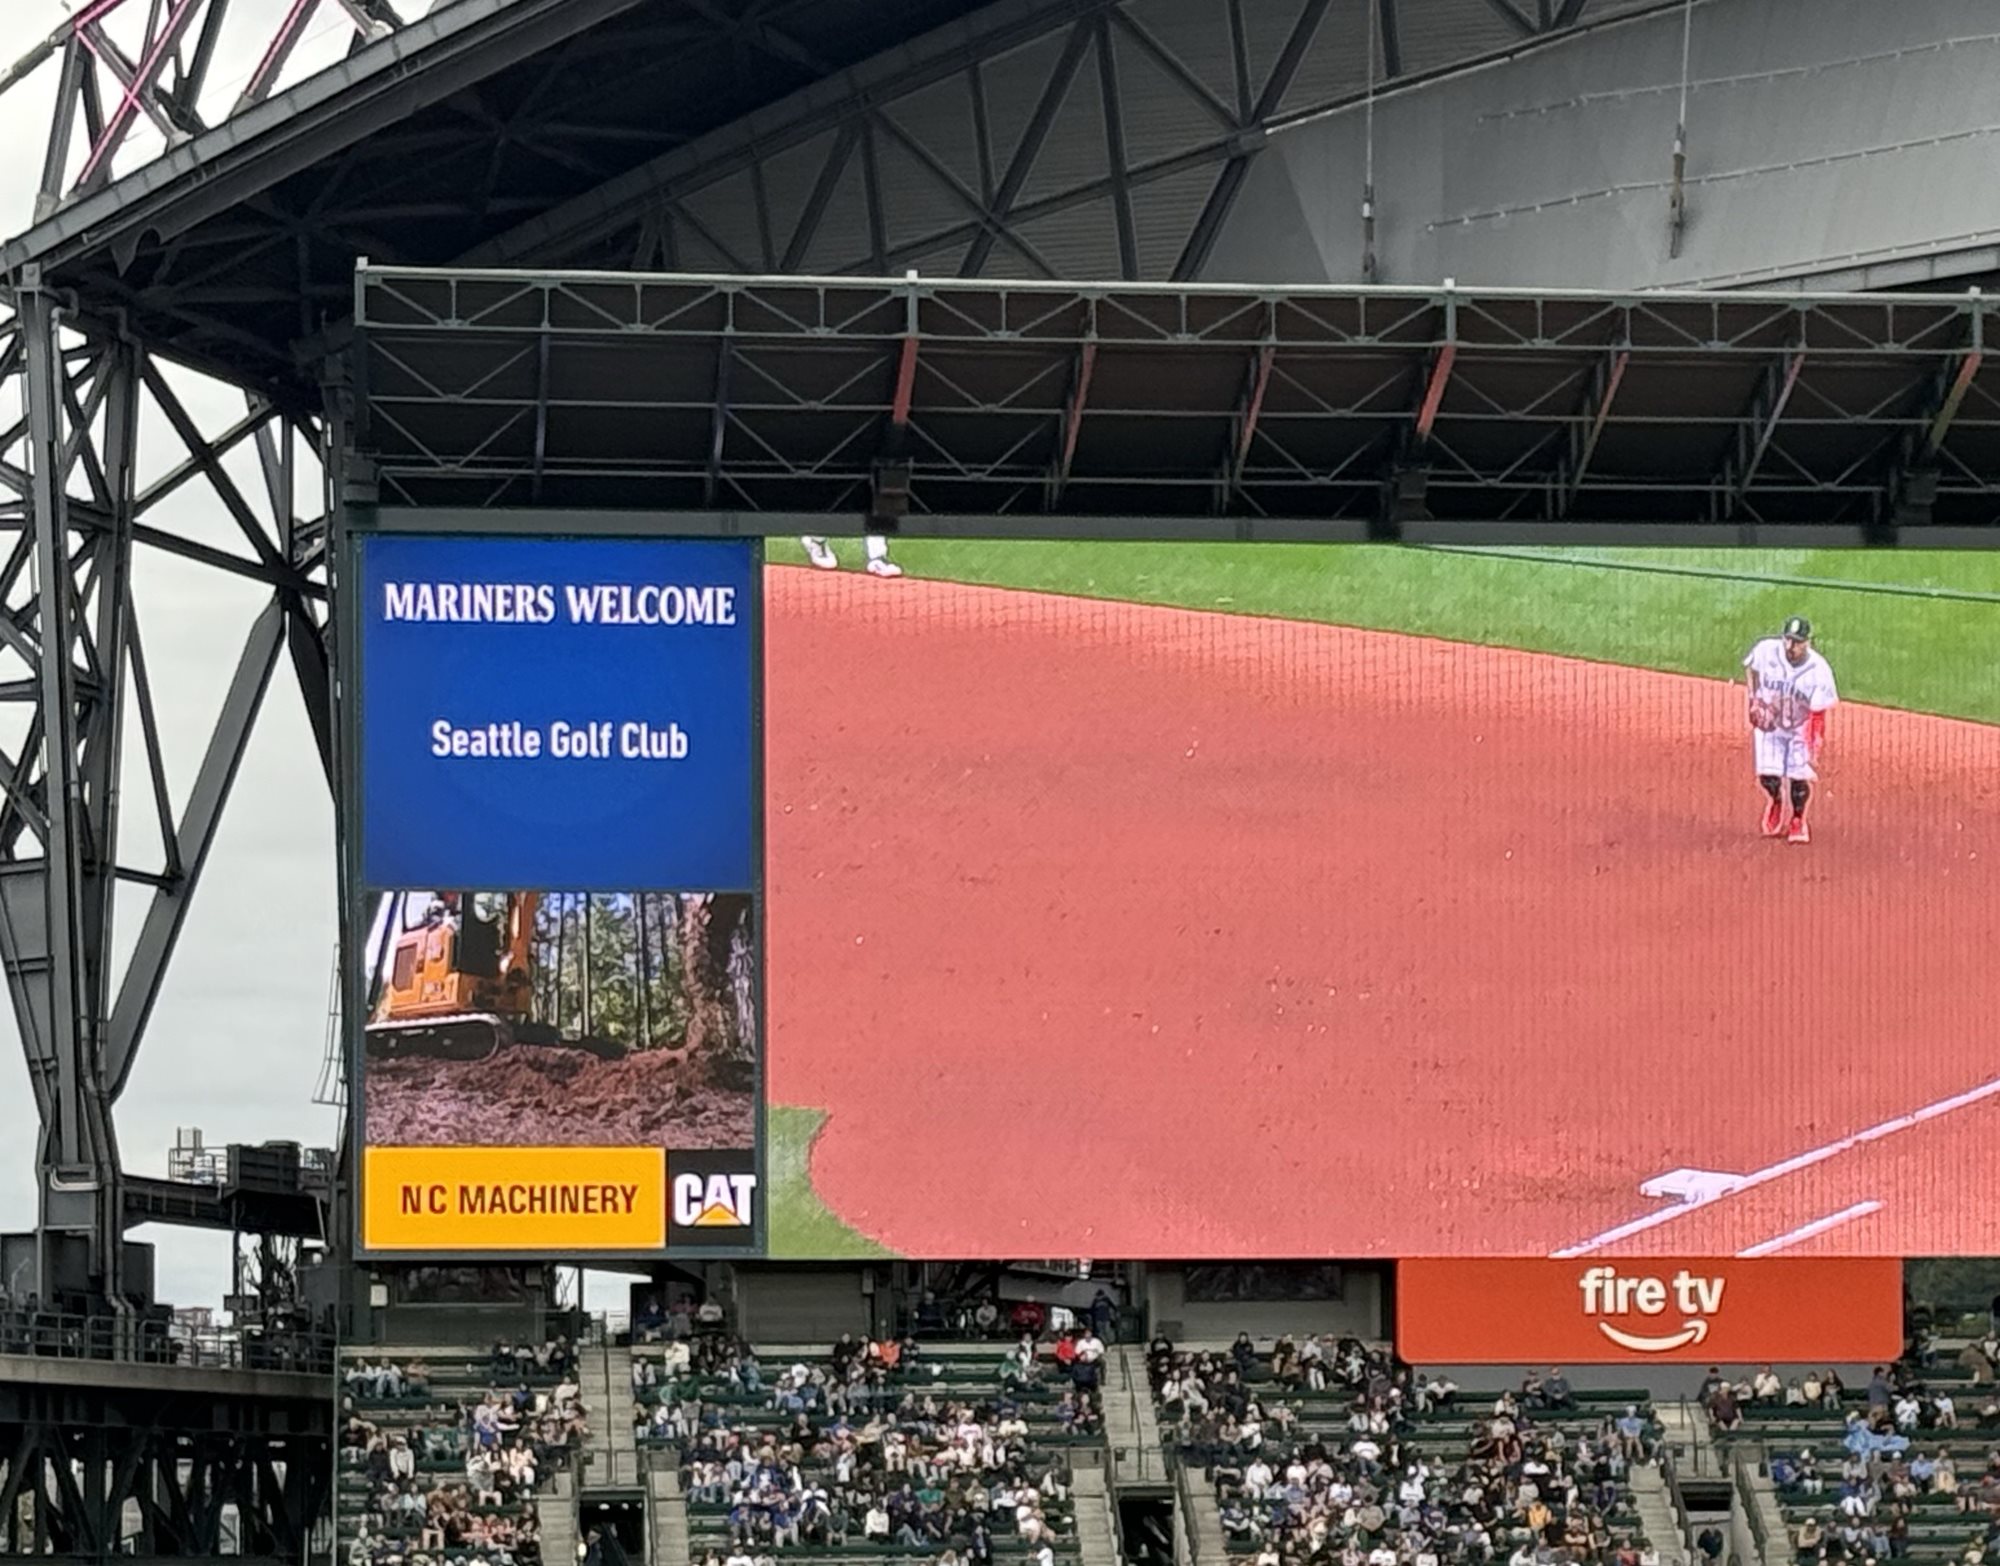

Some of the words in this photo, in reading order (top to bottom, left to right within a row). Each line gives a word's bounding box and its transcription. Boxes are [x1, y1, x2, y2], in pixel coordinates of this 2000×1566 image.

[384, 583, 555, 623] MARINERS
[565, 585, 736, 625] WELCOME
[431, 720, 541, 758] Seattle
[550, 721, 613, 759] Golf
[621, 722, 689, 759] Club
[459, 1184, 639, 1214] MACHINERY
[673, 1173, 757, 1226] CAT
[1579, 1266, 1667, 1314] fire
[1672, 1270, 1726, 1314] tv
